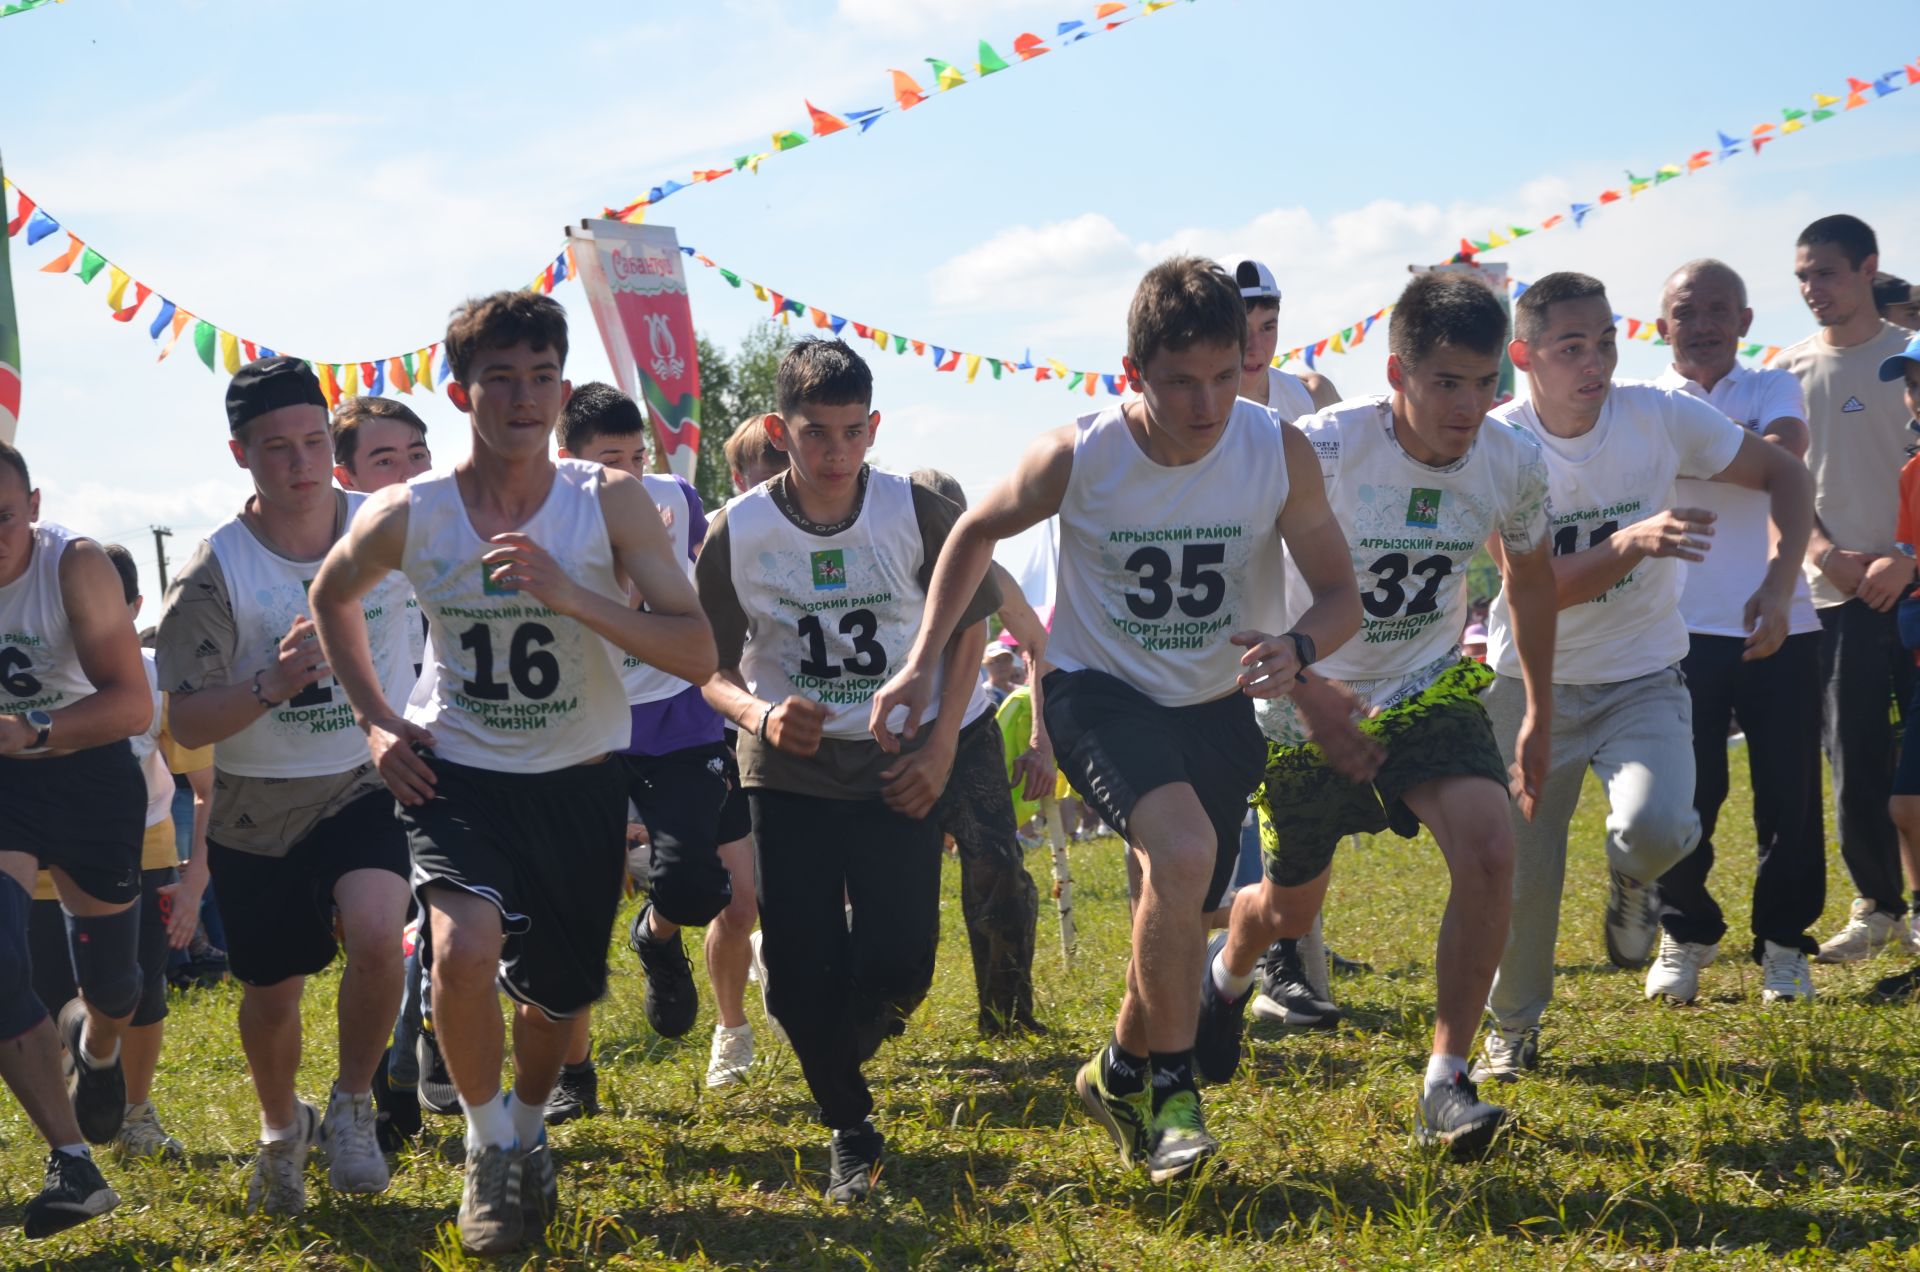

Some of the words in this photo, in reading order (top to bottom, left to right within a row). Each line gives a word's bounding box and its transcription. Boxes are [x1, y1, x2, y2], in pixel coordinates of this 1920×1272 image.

[1553, 508, 1599, 525] ЫЗСКИЙ
[1603, 501, 1641, 518] РАЙОН
[1109, 526, 1192, 542] АГРЫЗСКИЙ
[1196, 524, 1242, 539] РАЙОН
[1360, 536, 1433, 549] АГРЫЗСКИЙ
[1436, 539, 1475, 551] РАЙОН
[1124, 543, 1226, 620] 35
[852, 593, 892, 607] РАЙОН
[440, 604, 521, 619] АГРЫЗСКИЙ
[1174, 614, 1232, 635] НОРМА
[5, 633, 40, 646] РАЙОН
[798, 608, 888, 679] 13
[1142, 636, 1204, 651] ЖИЗНИ
[460, 622, 560, 701] 16
[455, 694, 499, 716] СПОРТ
[514, 697, 578, 716] НОРМА
[278, 706, 326, 723] СПОРТ
[483, 716, 546, 730] ЖИЗНИ
[310, 715, 356, 734] ЖИЗН
